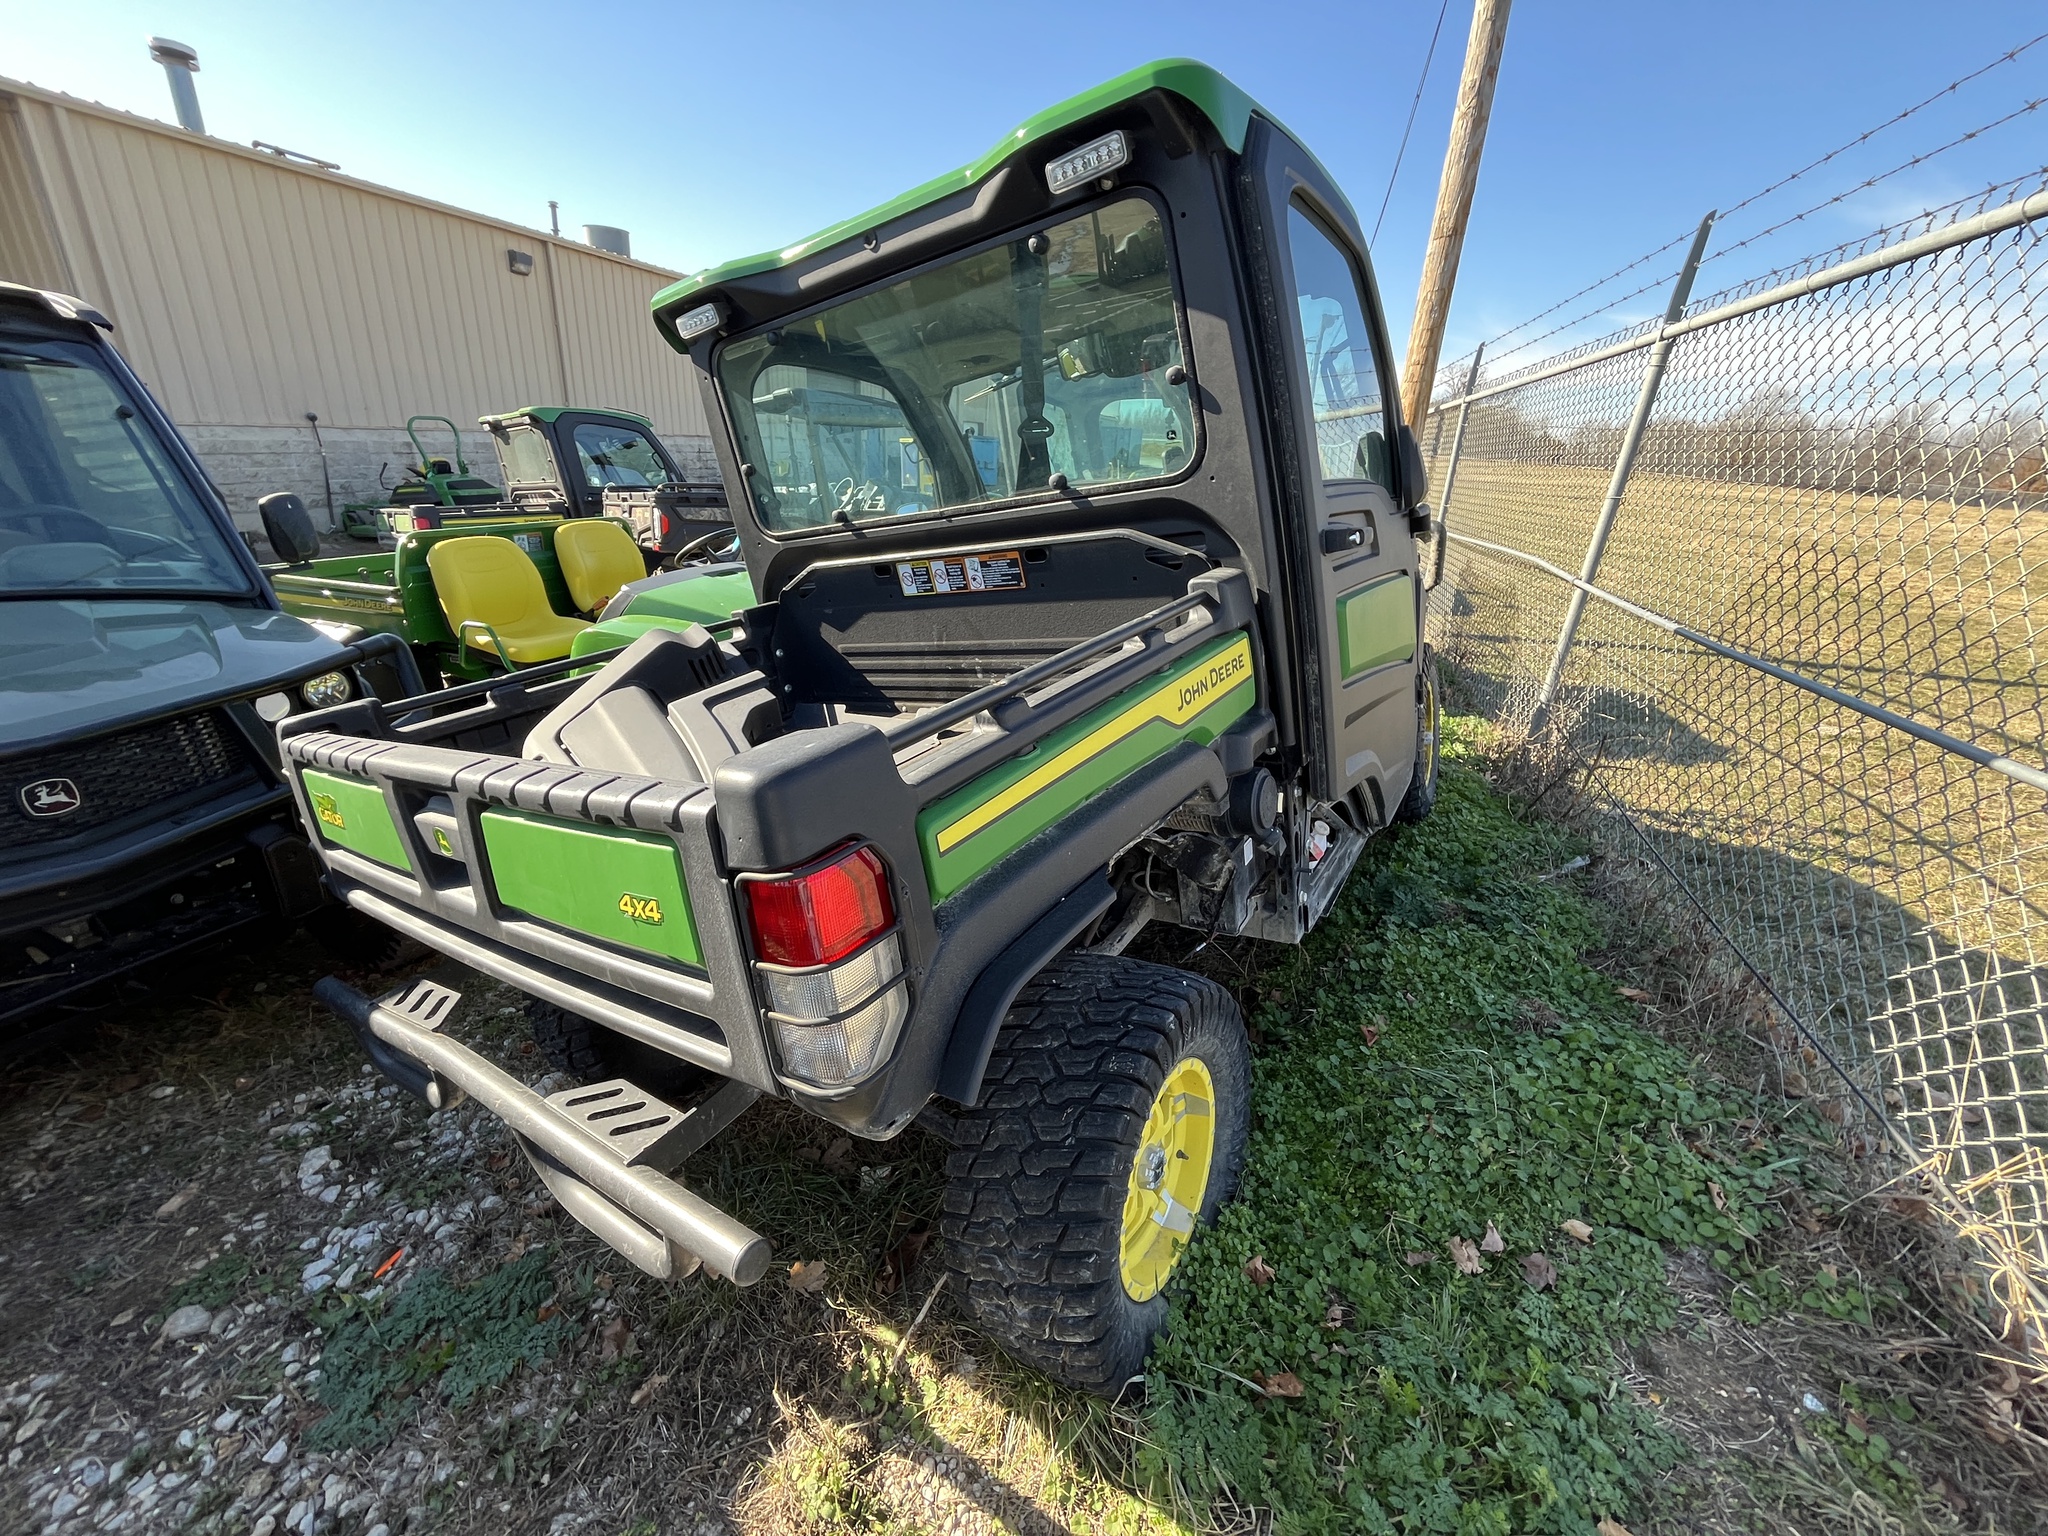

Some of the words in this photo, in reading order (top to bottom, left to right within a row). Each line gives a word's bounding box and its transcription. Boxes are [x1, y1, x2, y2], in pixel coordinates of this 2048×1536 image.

[364, 599, 392, 611] DEERE
[1178, 676, 1208, 711] JOHN
[1209, 653, 1244, 688] DEERE
[318, 806, 344, 828] GATOR
